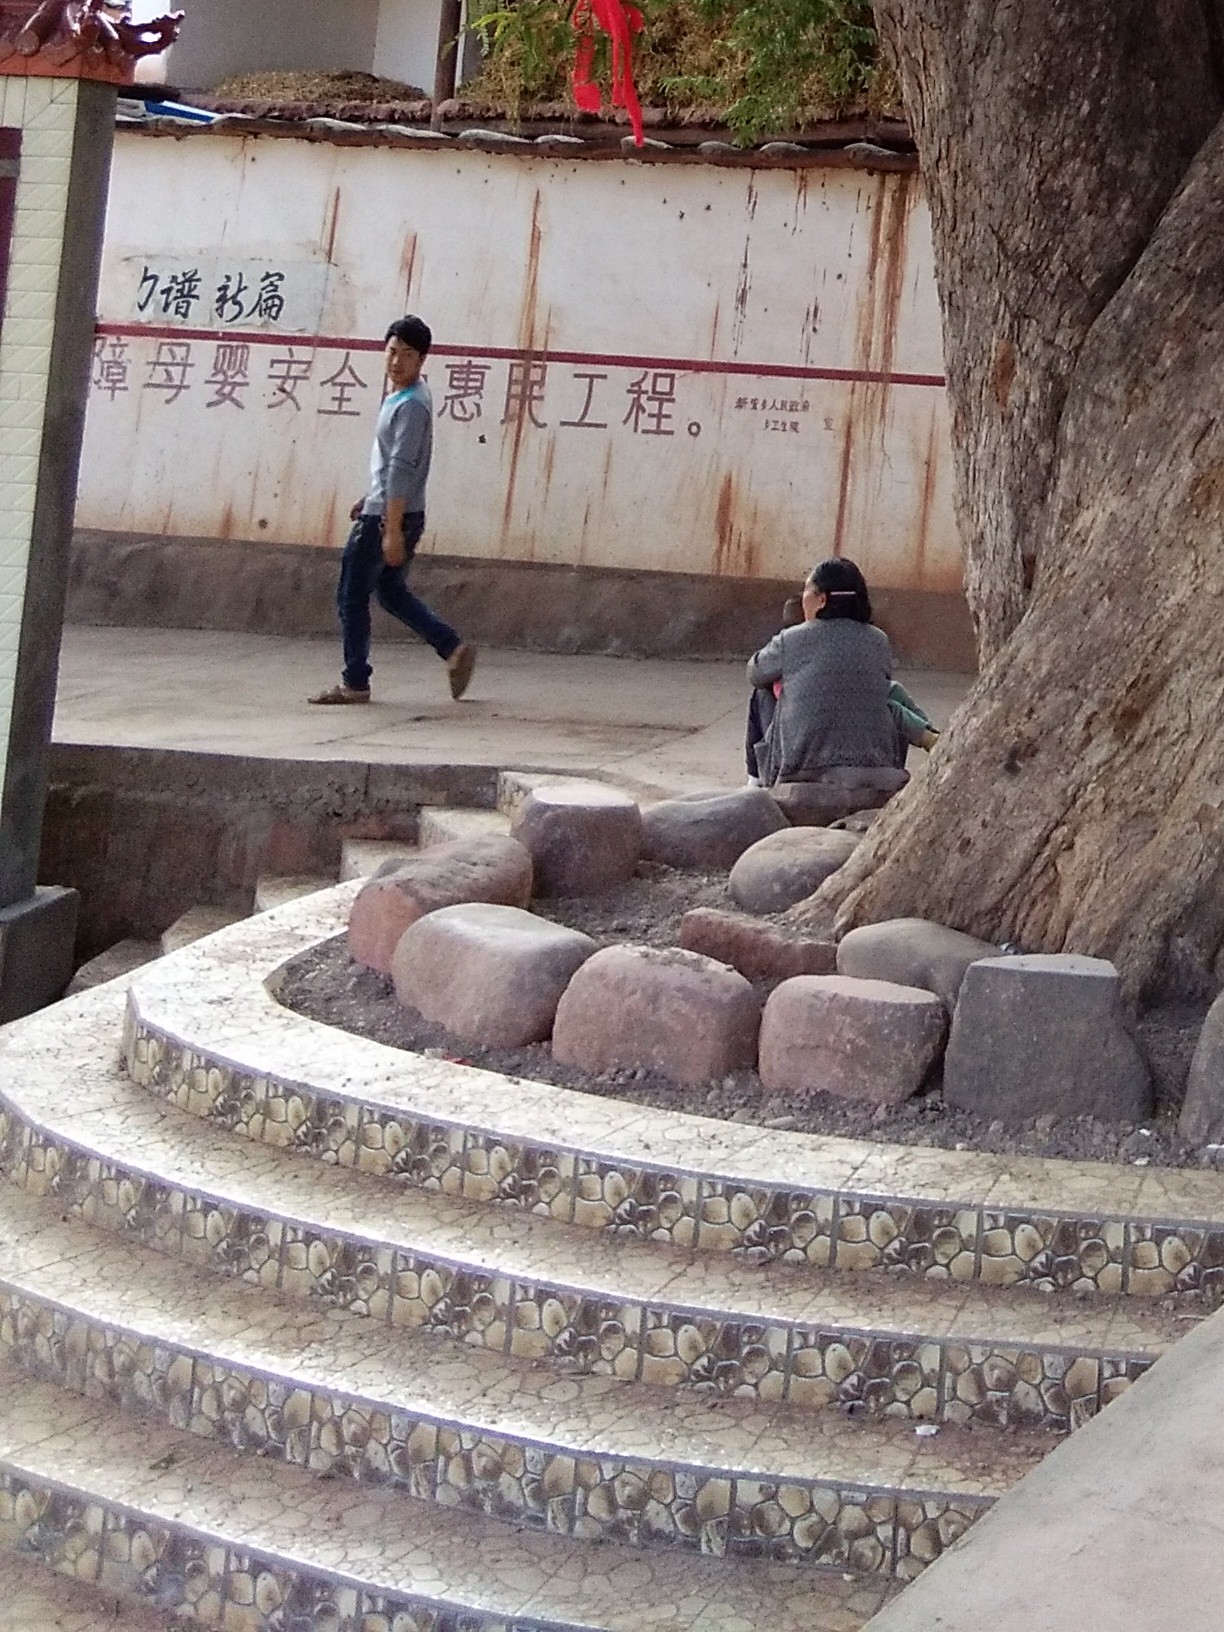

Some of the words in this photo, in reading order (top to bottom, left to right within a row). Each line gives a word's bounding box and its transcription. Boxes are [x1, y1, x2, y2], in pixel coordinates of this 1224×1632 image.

[92, 335, 702, 438] 障母婴安全惠民工程。
